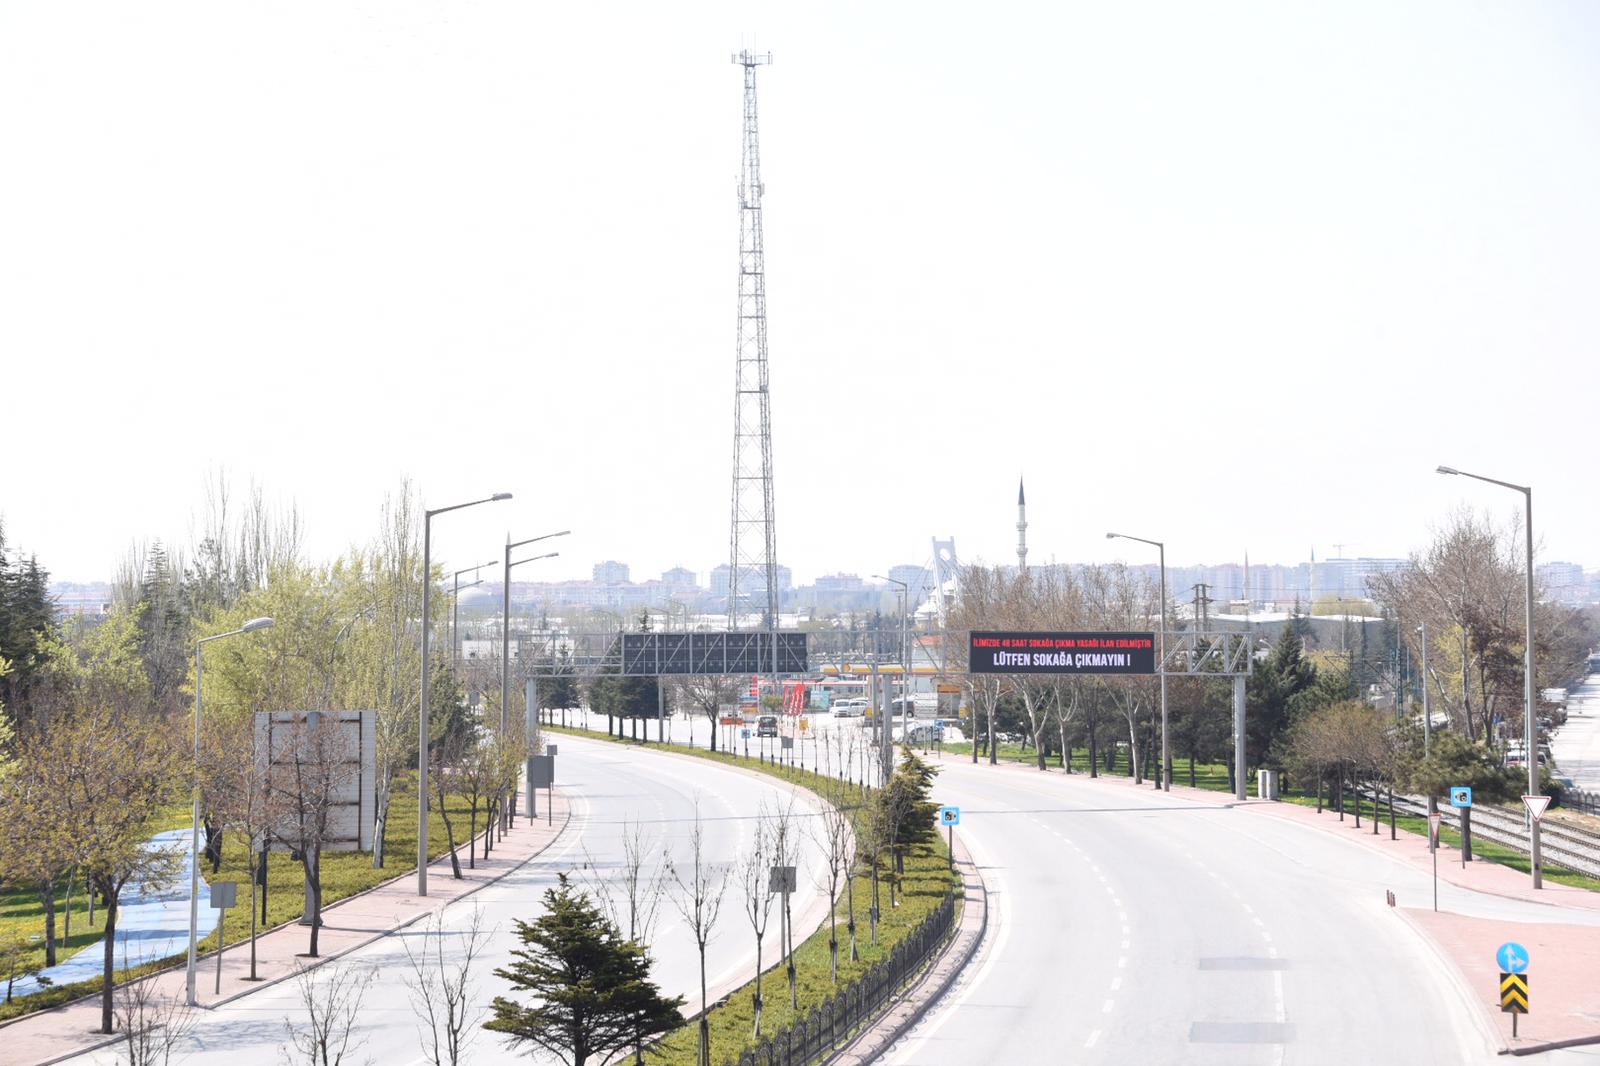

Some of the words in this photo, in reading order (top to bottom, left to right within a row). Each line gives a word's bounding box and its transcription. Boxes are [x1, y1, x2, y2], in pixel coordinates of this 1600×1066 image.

[1012, 639, 1028, 647] SAAT
[1029, 638, 1054, 647] SOKAĞA
[993, 651, 1031, 666] LÜTFEN
[1033, 651, 1073, 666] SOKAĞA
[1075, 653, 1125, 668] ÇIKMAYIN
